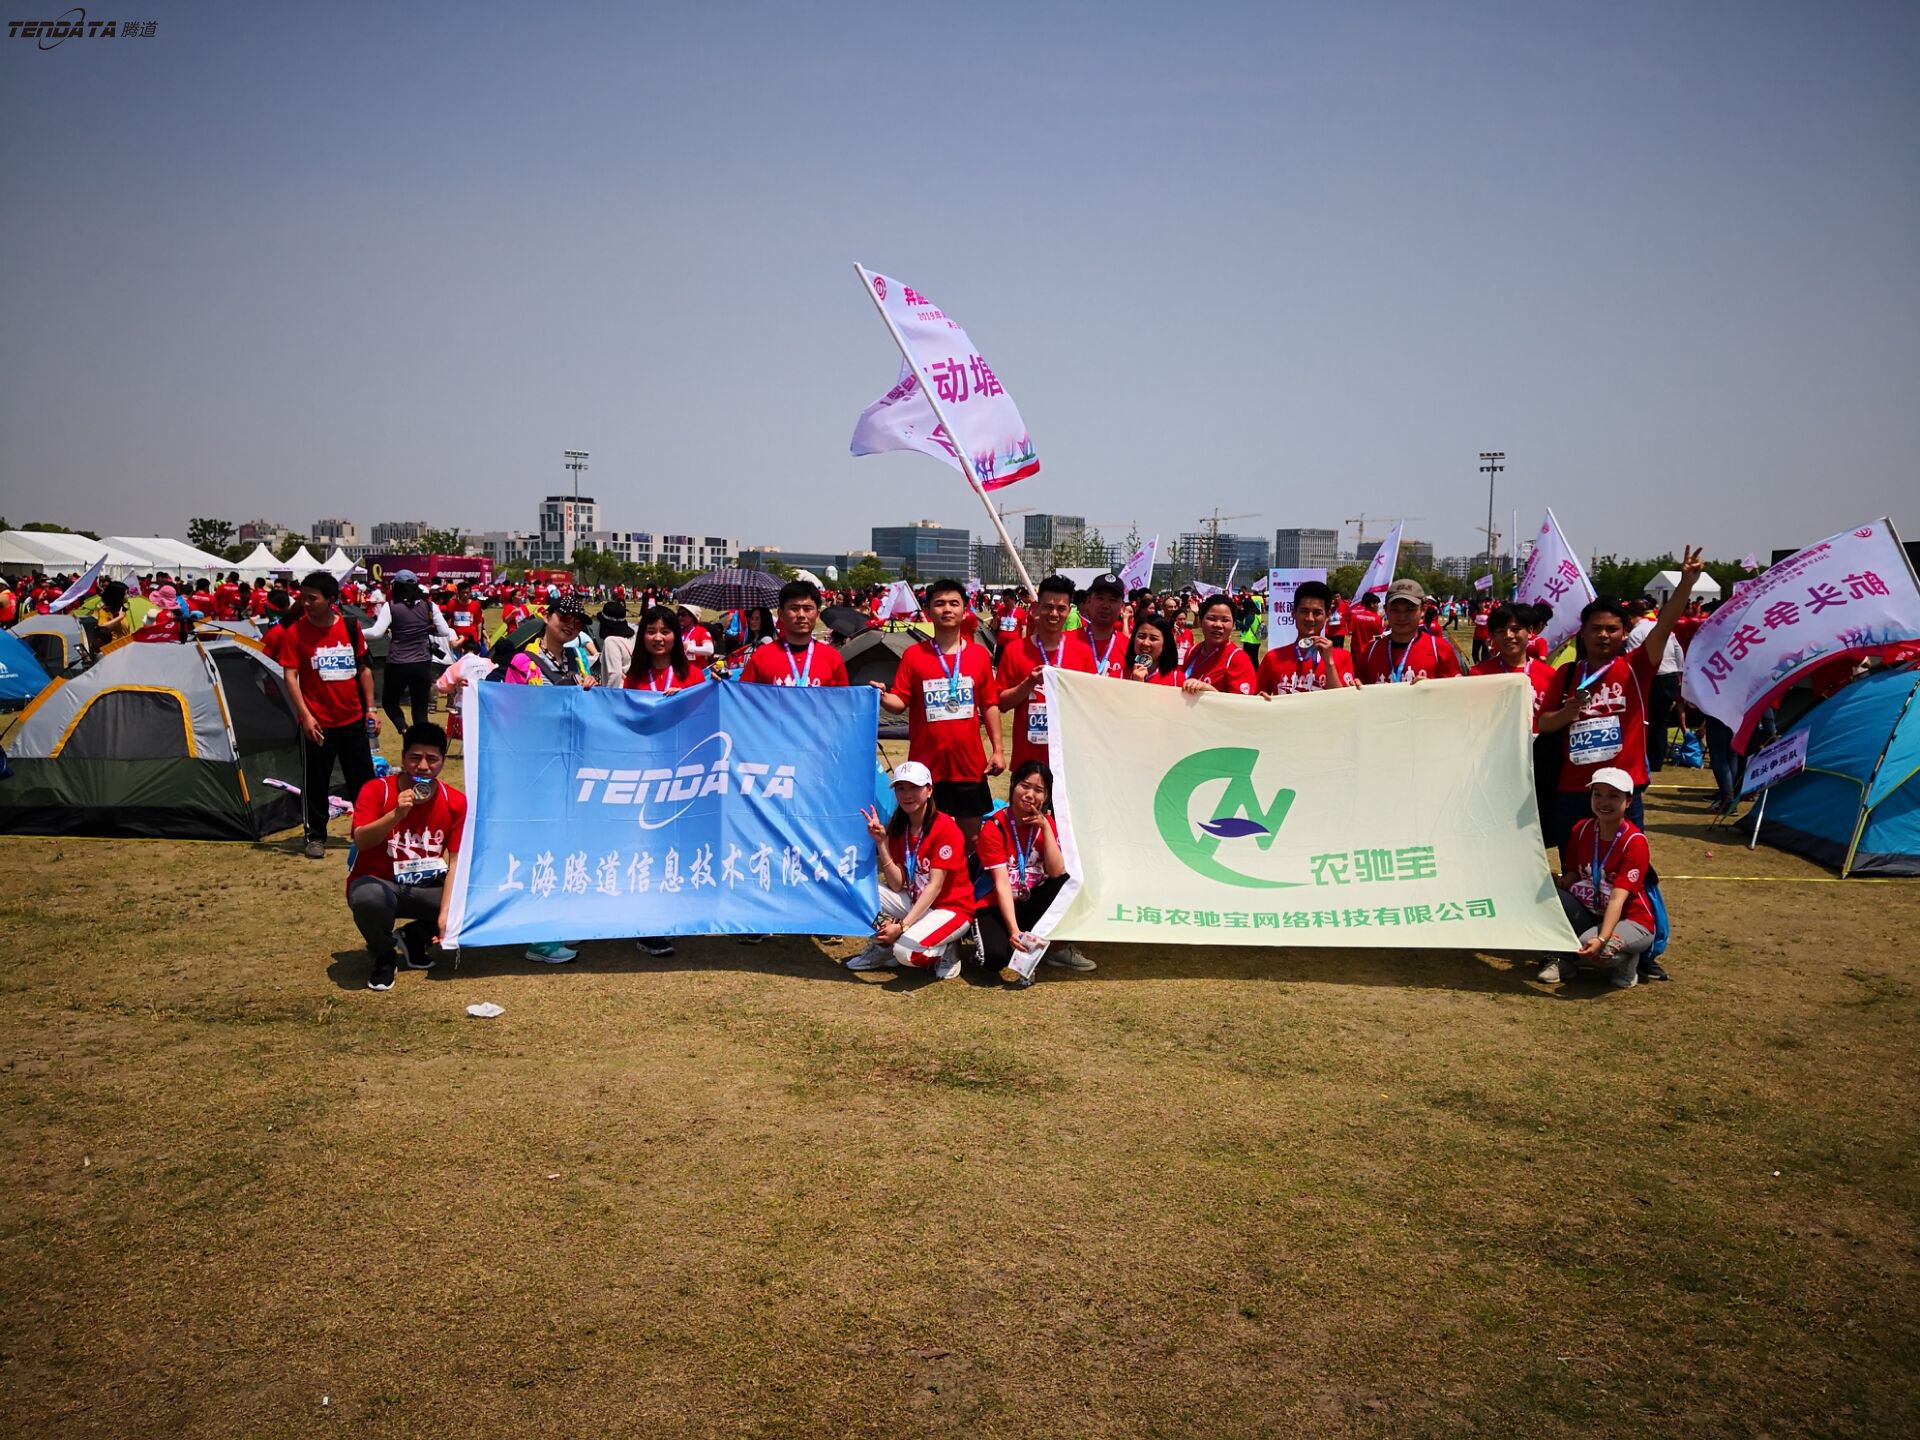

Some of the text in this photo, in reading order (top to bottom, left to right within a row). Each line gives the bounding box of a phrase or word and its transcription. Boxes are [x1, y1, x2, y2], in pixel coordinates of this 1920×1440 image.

[1570, 728, 1619, 748] 042-26
[576, 760, 796, 804] TENDATA
[498, 843, 858, 898] 上海腾道信息技术有限公司
[1310, 846, 1437, 886] 农驰宝
[1107, 898, 1496, 928] 上海农驰宝网络科技有限公司
